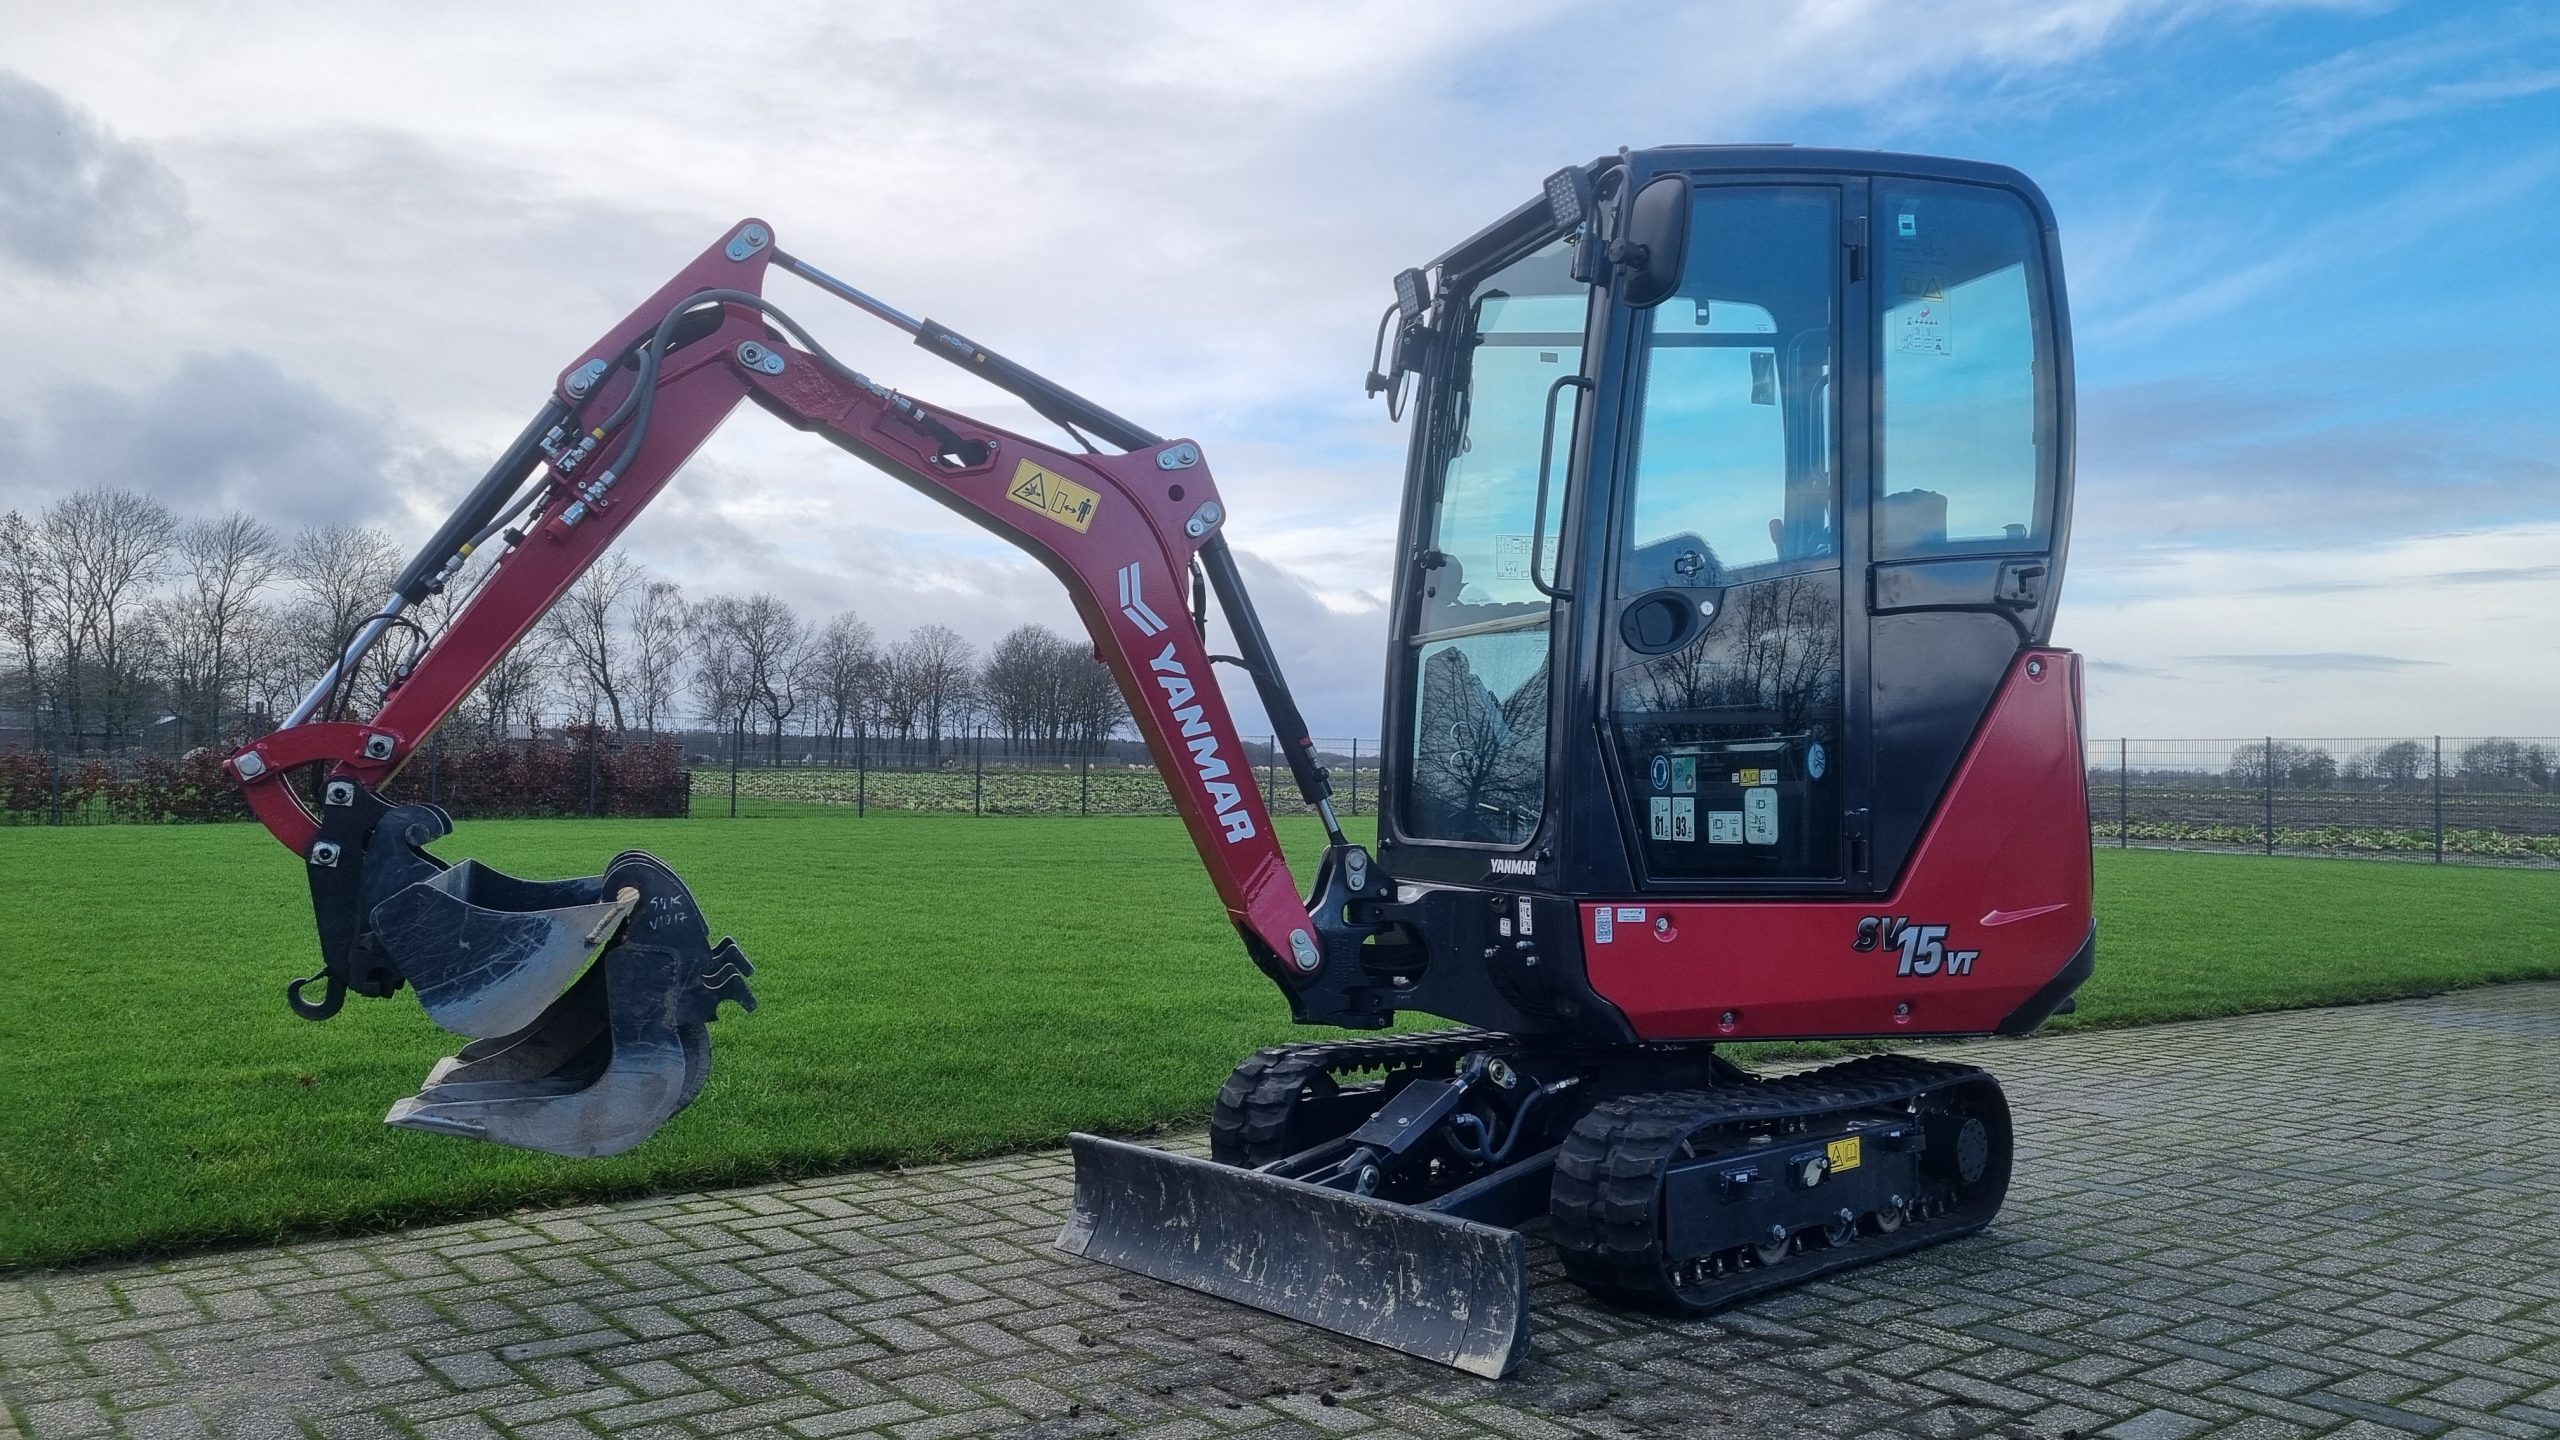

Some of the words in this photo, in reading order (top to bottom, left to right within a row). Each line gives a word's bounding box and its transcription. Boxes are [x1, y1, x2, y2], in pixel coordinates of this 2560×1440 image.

[1149, 641, 1256, 844] YANMAR
[1655, 815, 1664, 836] 81
[1675, 816, 1687, 837] 93
[1490, 858, 1537, 876] YANMAR
